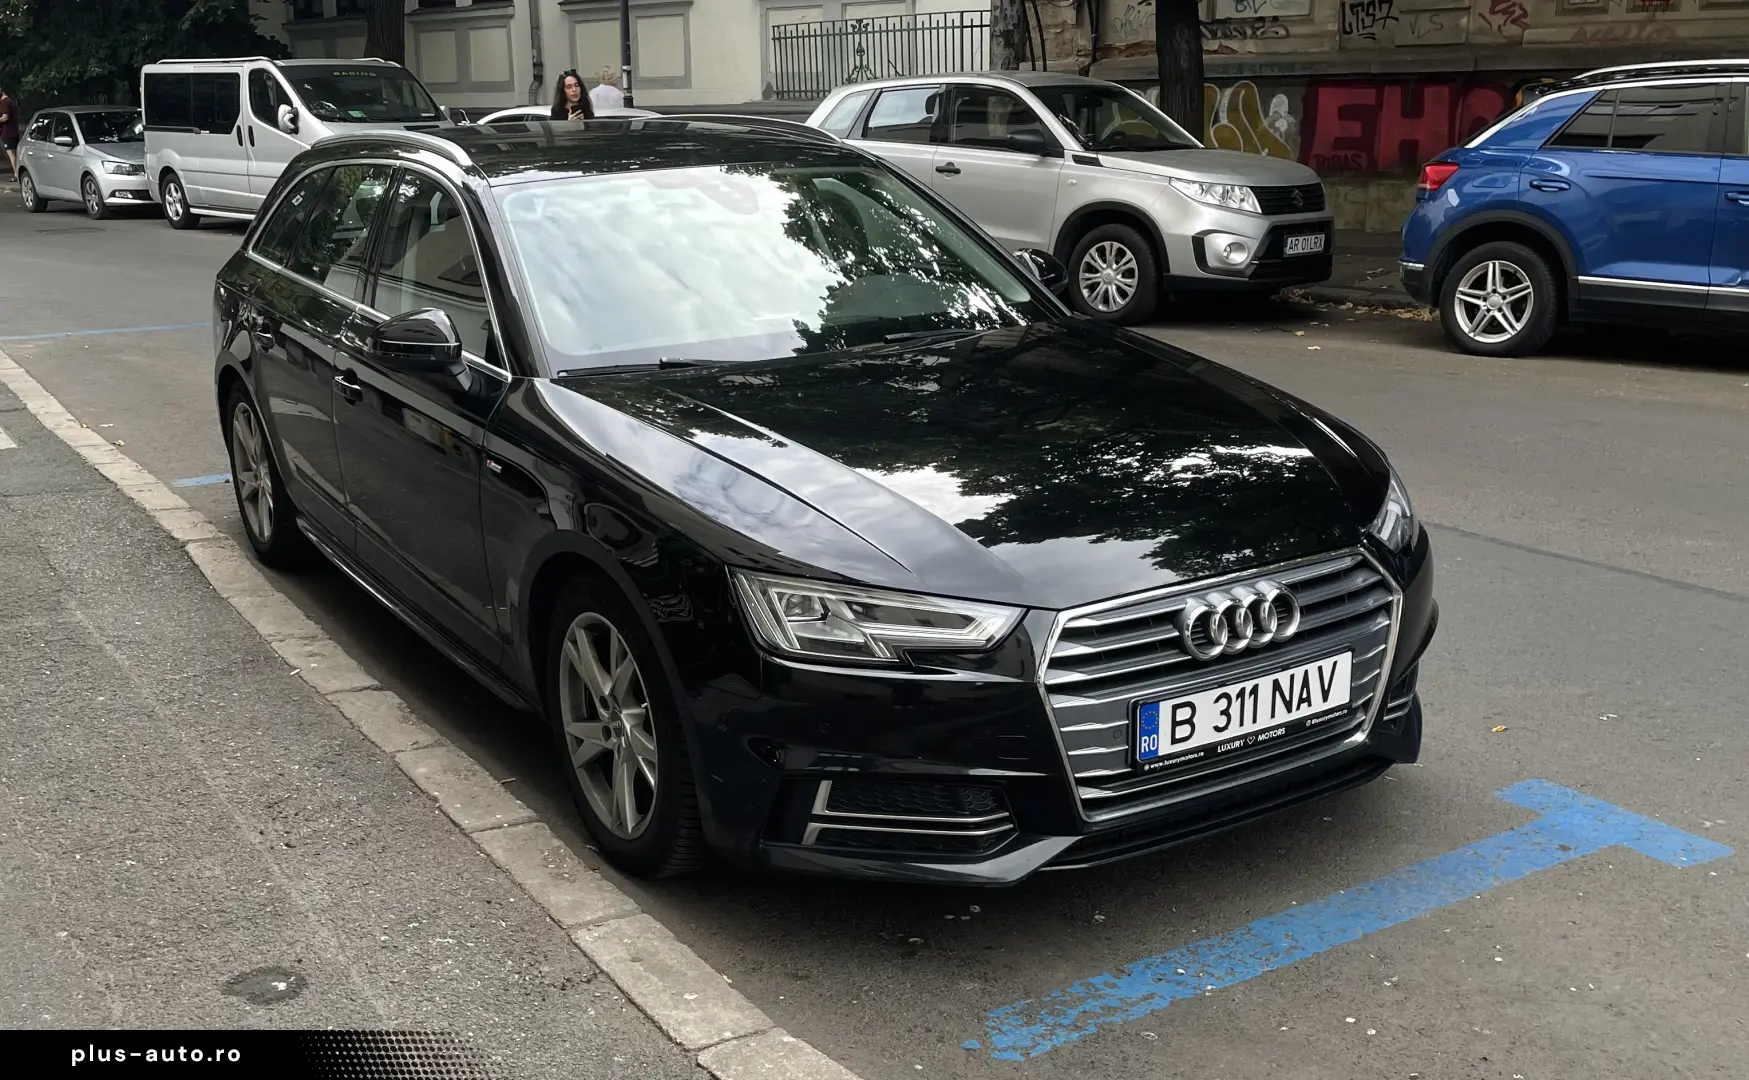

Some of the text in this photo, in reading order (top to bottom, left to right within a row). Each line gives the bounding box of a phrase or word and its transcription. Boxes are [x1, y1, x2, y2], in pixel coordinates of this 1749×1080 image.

[1288, 238, 1300, 253] AR
[1141, 660, 1338, 753] RO B 311 NAV
[1217, 727, 1286, 753] LUXURY MOTORS
[1150, 751, 1205, 769] www.luxurymotors.ro
